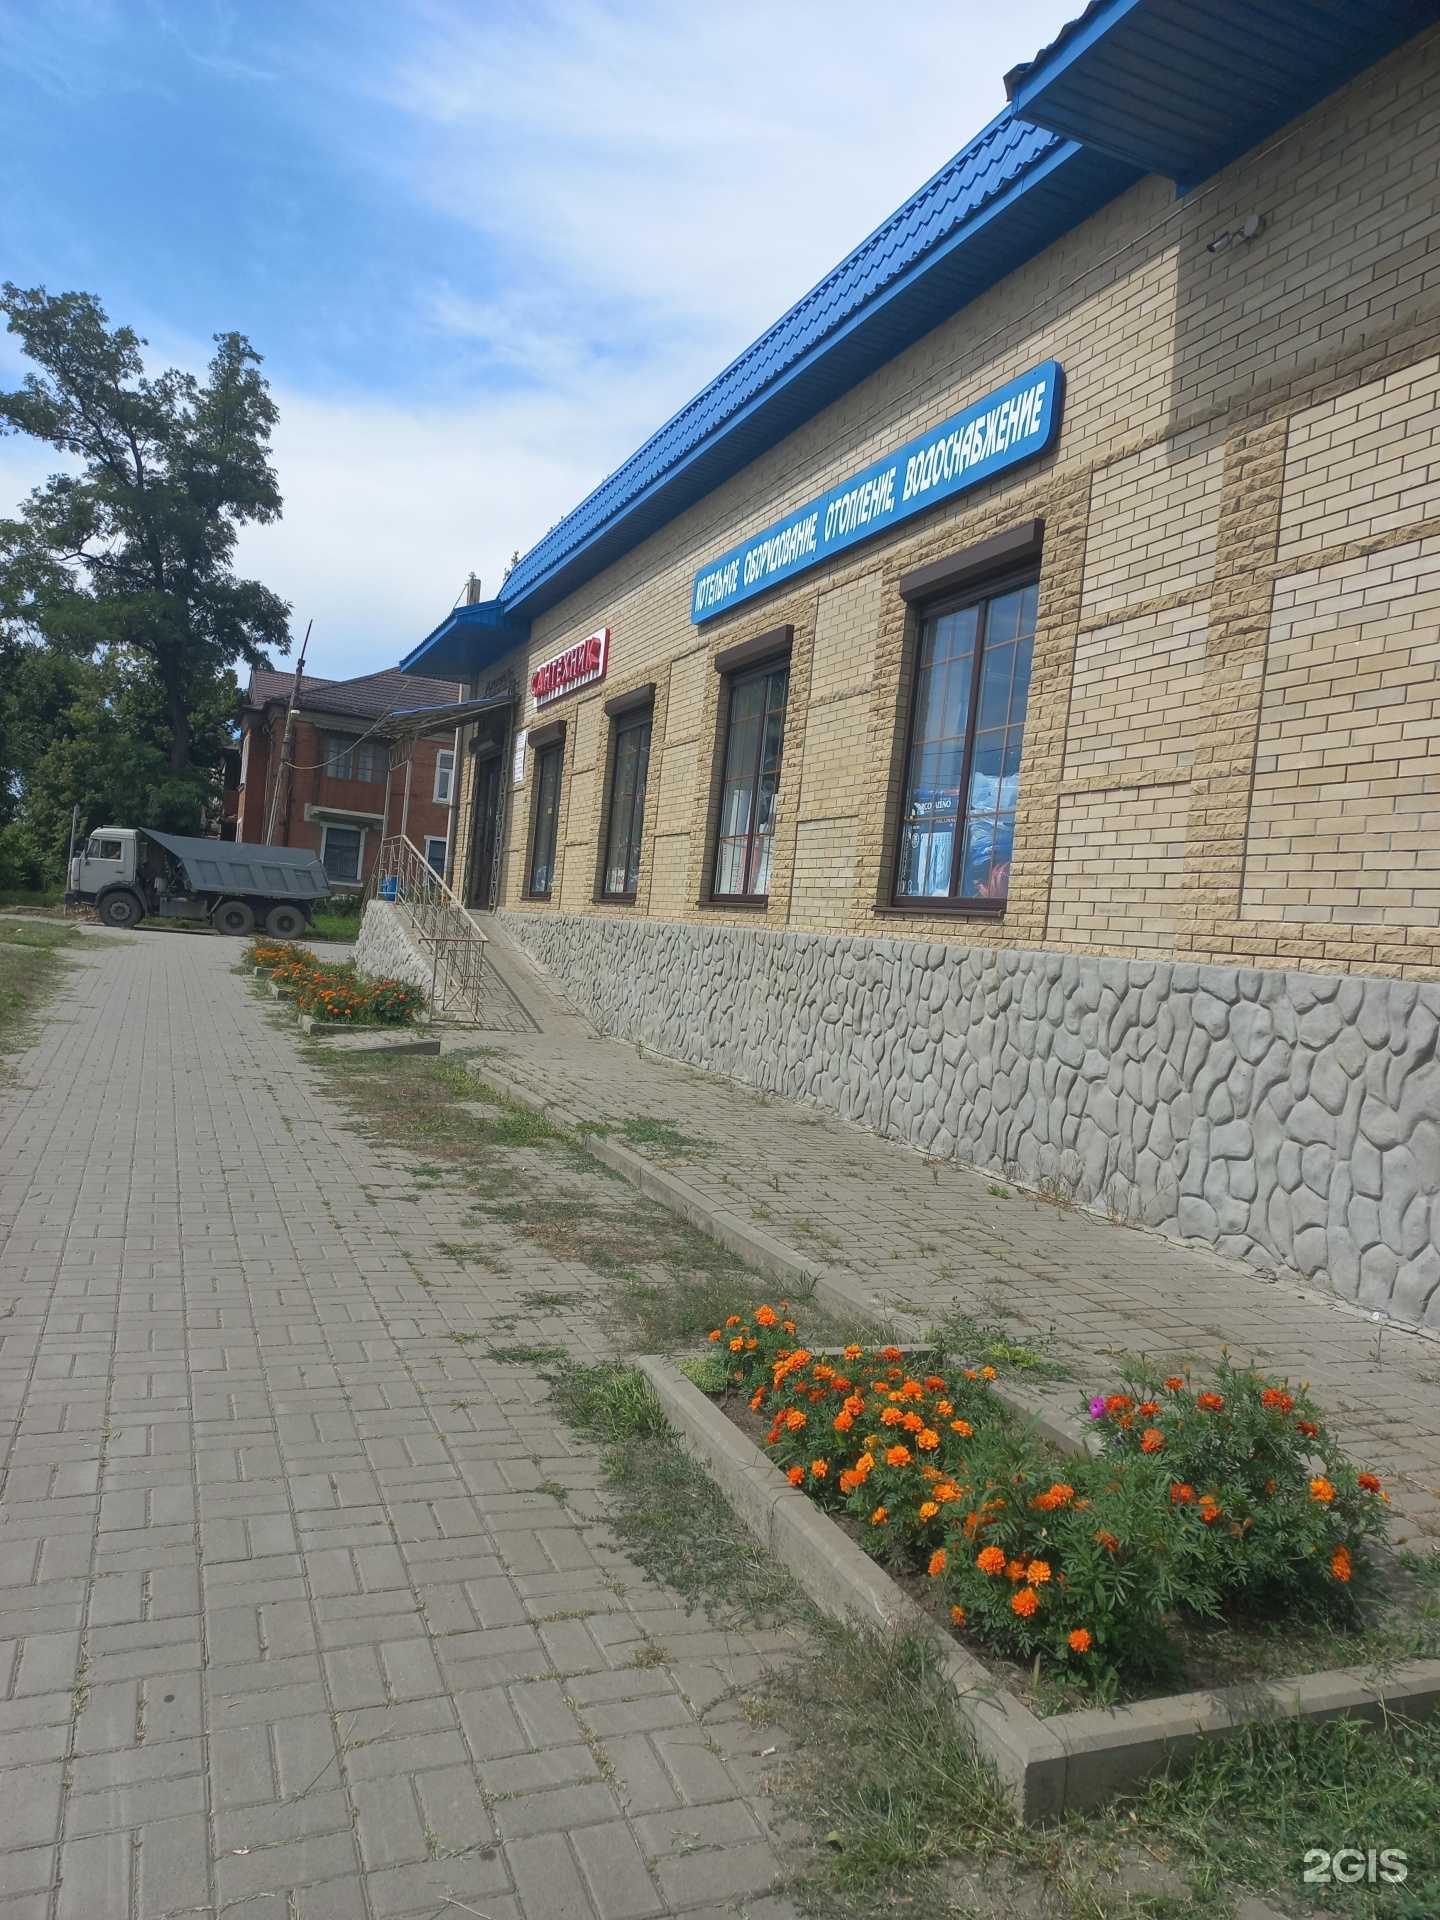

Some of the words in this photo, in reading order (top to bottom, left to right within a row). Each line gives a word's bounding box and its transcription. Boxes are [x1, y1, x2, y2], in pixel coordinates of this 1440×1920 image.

[695, 558, 740, 612] КОТЕЛЬНОЕ
[743, 511, 819, 586] ОБОРУДОВАНИЕ,
[824, 466, 897, 542] ОТОПЛЕНИЕ,
[902, 380, 1046, 501] ВОДОСНАБЖЕНИЕ
